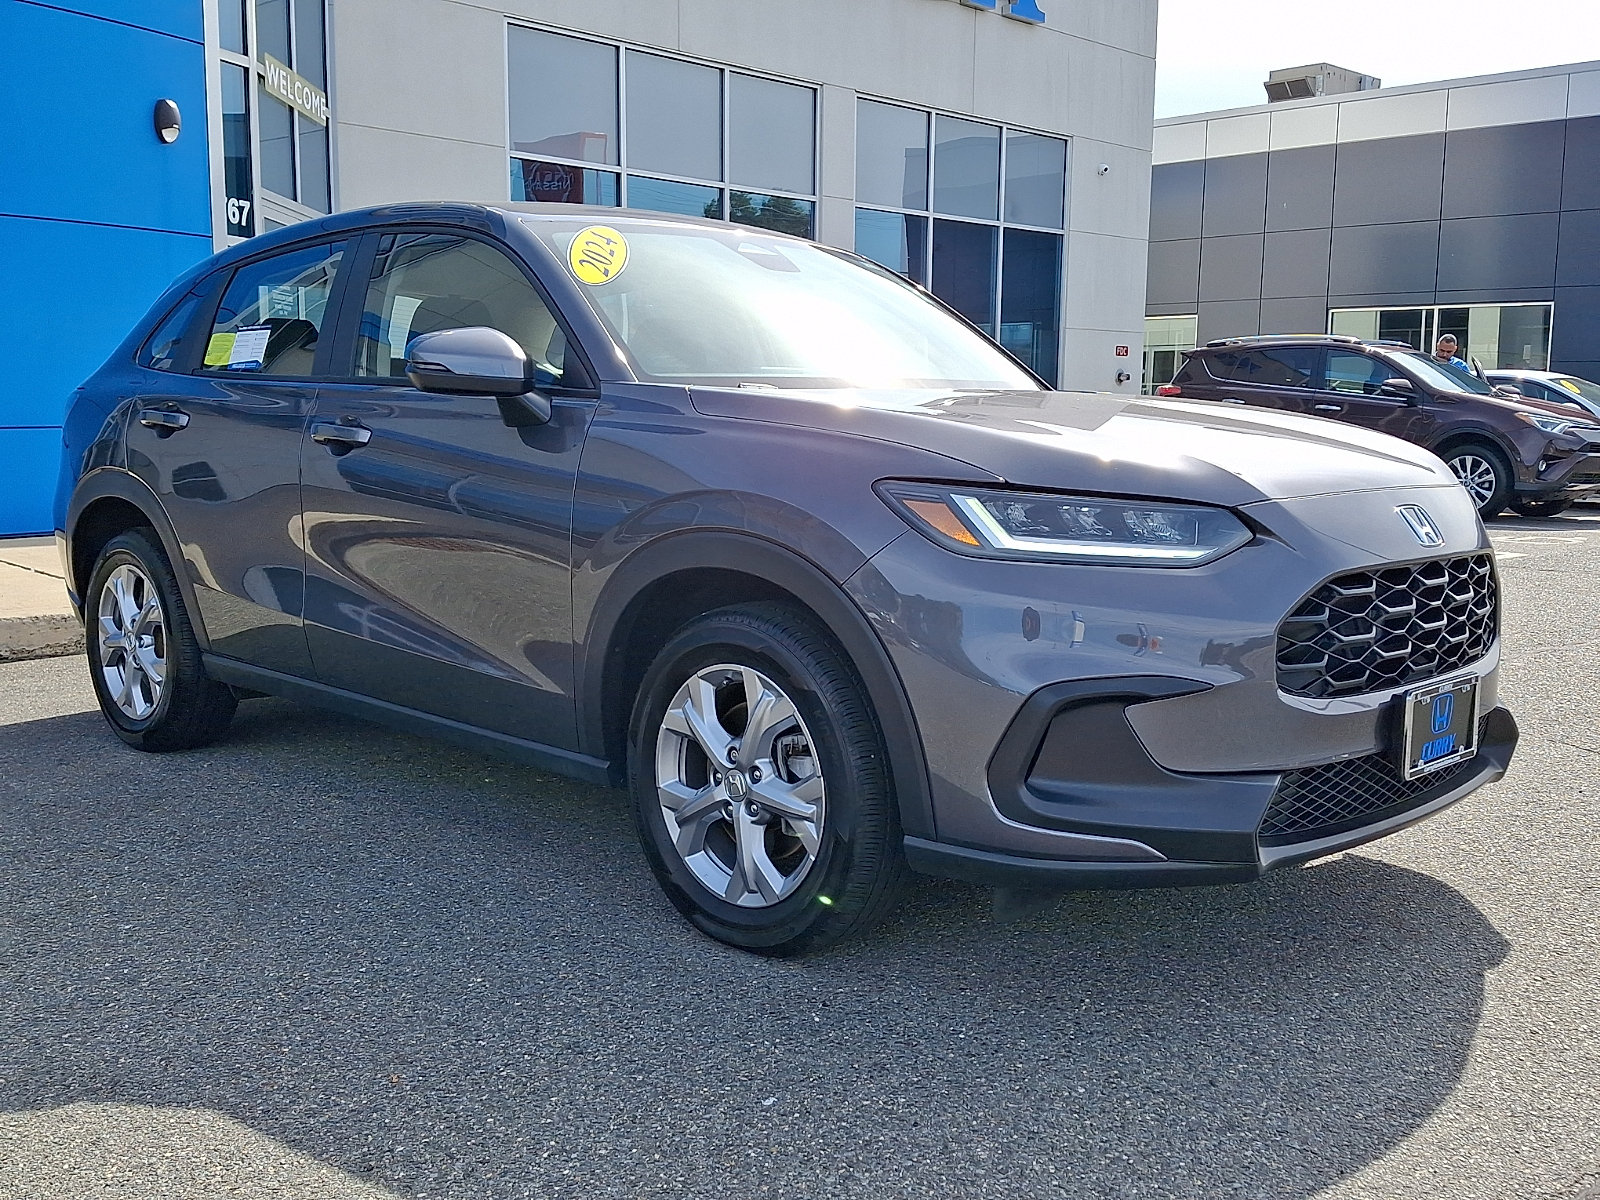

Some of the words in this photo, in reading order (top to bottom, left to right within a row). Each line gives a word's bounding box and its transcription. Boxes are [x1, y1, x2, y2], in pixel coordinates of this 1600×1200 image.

[265, 59, 326, 120] WELCOME
[225, 197, 251, 227] 67
[578, 230, 618, 277] 2024
[1421, 732, 1457, 762] CURRY
